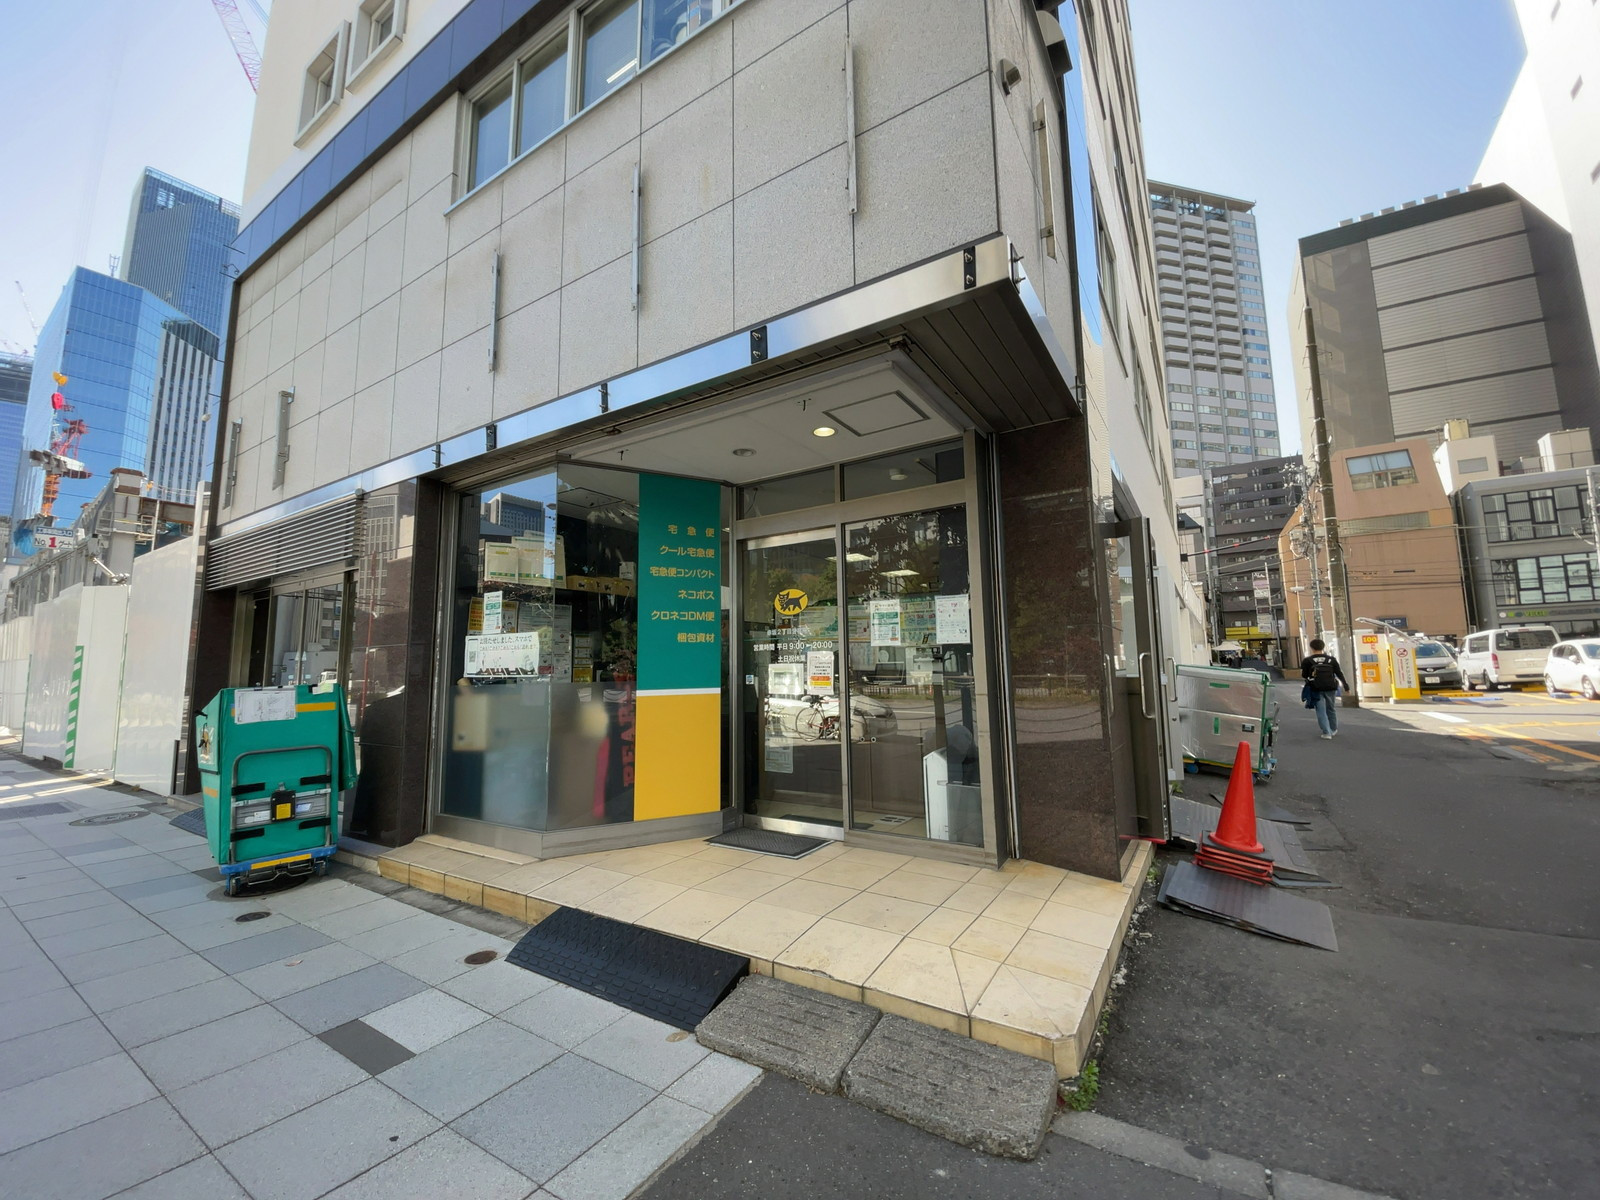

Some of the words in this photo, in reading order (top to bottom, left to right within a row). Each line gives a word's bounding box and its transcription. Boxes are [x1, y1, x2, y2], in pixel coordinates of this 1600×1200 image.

[49, 537, 57, 548] 1
[660, 545, 715, 558] クール宅急便
[649, 566, 715, 579] 宅急便コンパクト
[678, 589, 715, 600] ネコポス
[651, 610, 715, 622] クロネコDM便
[677, 633, 715, 643] 梱包資材
[1363, 635, 1378, 643] 100
[753, 643, 775, 651] 営業時間
